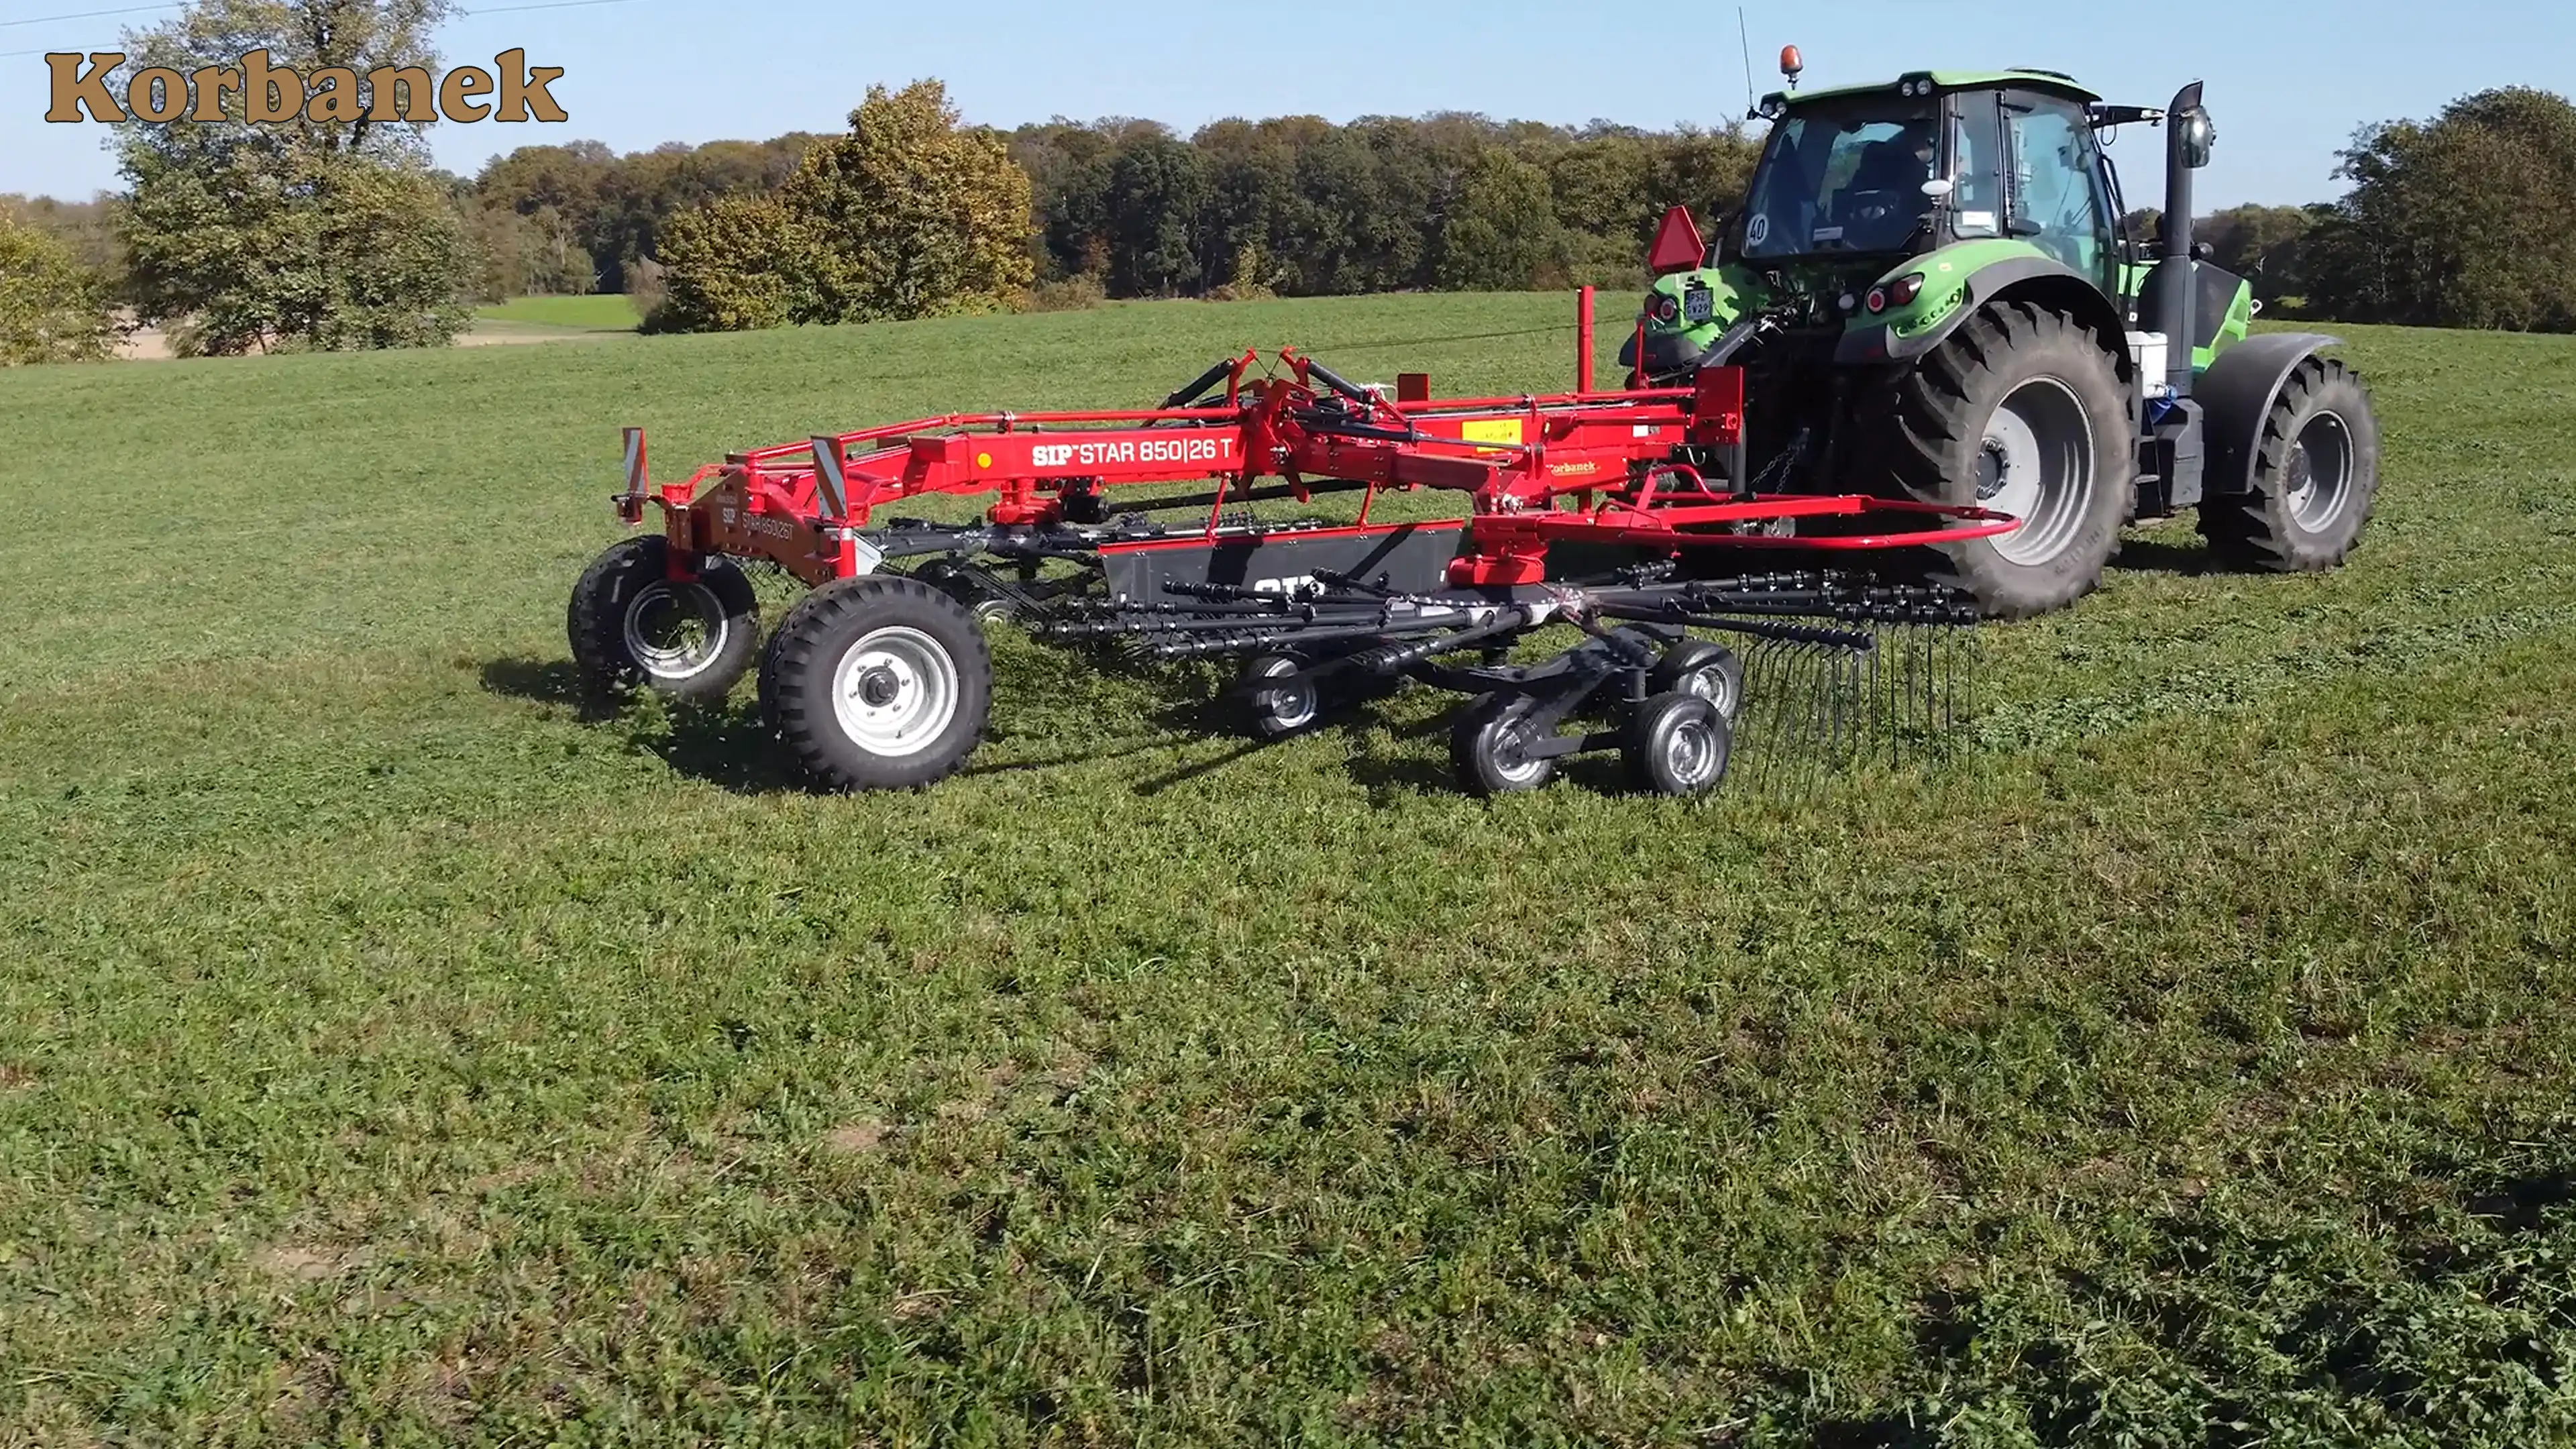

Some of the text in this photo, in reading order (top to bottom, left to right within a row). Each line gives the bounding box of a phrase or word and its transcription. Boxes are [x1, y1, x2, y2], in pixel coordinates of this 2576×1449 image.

[1750, 218, 1766, 241] 40
[1032, 438, 1233, 466] SIP STAR 850|26 T
[1546, 461, 1595, 473] orbanek
